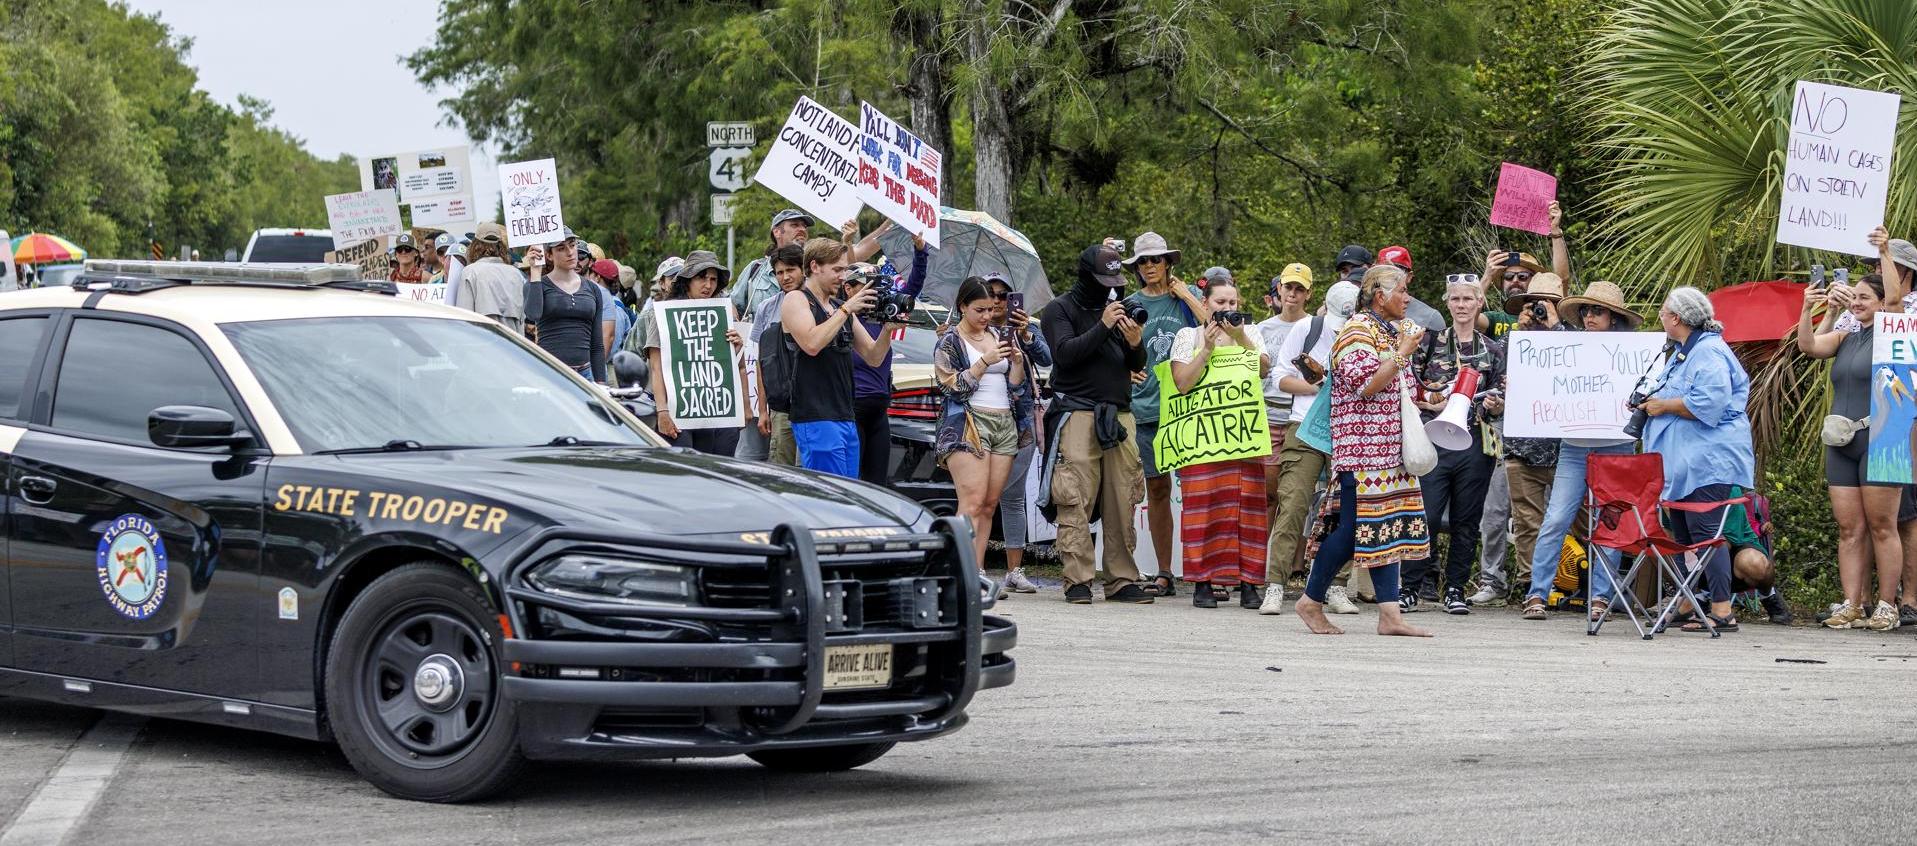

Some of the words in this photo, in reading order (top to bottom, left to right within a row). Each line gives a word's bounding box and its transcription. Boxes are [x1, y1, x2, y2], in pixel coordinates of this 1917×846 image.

[795, 101, 823, 127] NOT
[816, 113, 852, 146] LAND
[1794, 87, 1847, 134] NO
[711, 127, 753, 141] NORTH
[781, 126, 858, 187] CONCENTRATI
[1789, 138, 1840, 165] HUMAN
[1848, 149, 1883, 172] CAGES
[513, 170, 544, 186] ONLY
[716, 156, 735, 182] 4
[792, 162, 837, 202] CAMPS!
[1786, 172, 1810, 193] ON
[1817, 177, 1867, 199] STOLEN
[511, 214, 559, 237] EVERGLADES
[1787, 204, 1847, 231] LAND!!!
[335, 239, 379, 264] DEFEND
[411, 287, 428, 302] NO
[673, 309, 719, 340] KEEP
[683, 337, 715, 362] THE
[1516, 338, 1583, 369] PROTECT
[1601, 343, 1652, 375] YOUR
[678, 361, 724, 387] LAND
[1552, 375, 1615, 396] MOTHER
[680, 386, 733, 417] SACRED
[1168, 379, 1254, 419] ALLIGATOR
[1532, 400, 1597, 425] ABOLISH
[1160, 409, 1263, 466] ALCATRAZ
[274, 484, 360, 516] STATE
[368, 492, 509, 534] TROOPER
[103, 517, 160, 545] FLORIDA
[98, 567, 140, 617] HIGHWAY
[142, 570, 168, 616] PATROL
[828, 653, 860, 673] ARRIVE
[862, 652, 889, 671] ALIVE
